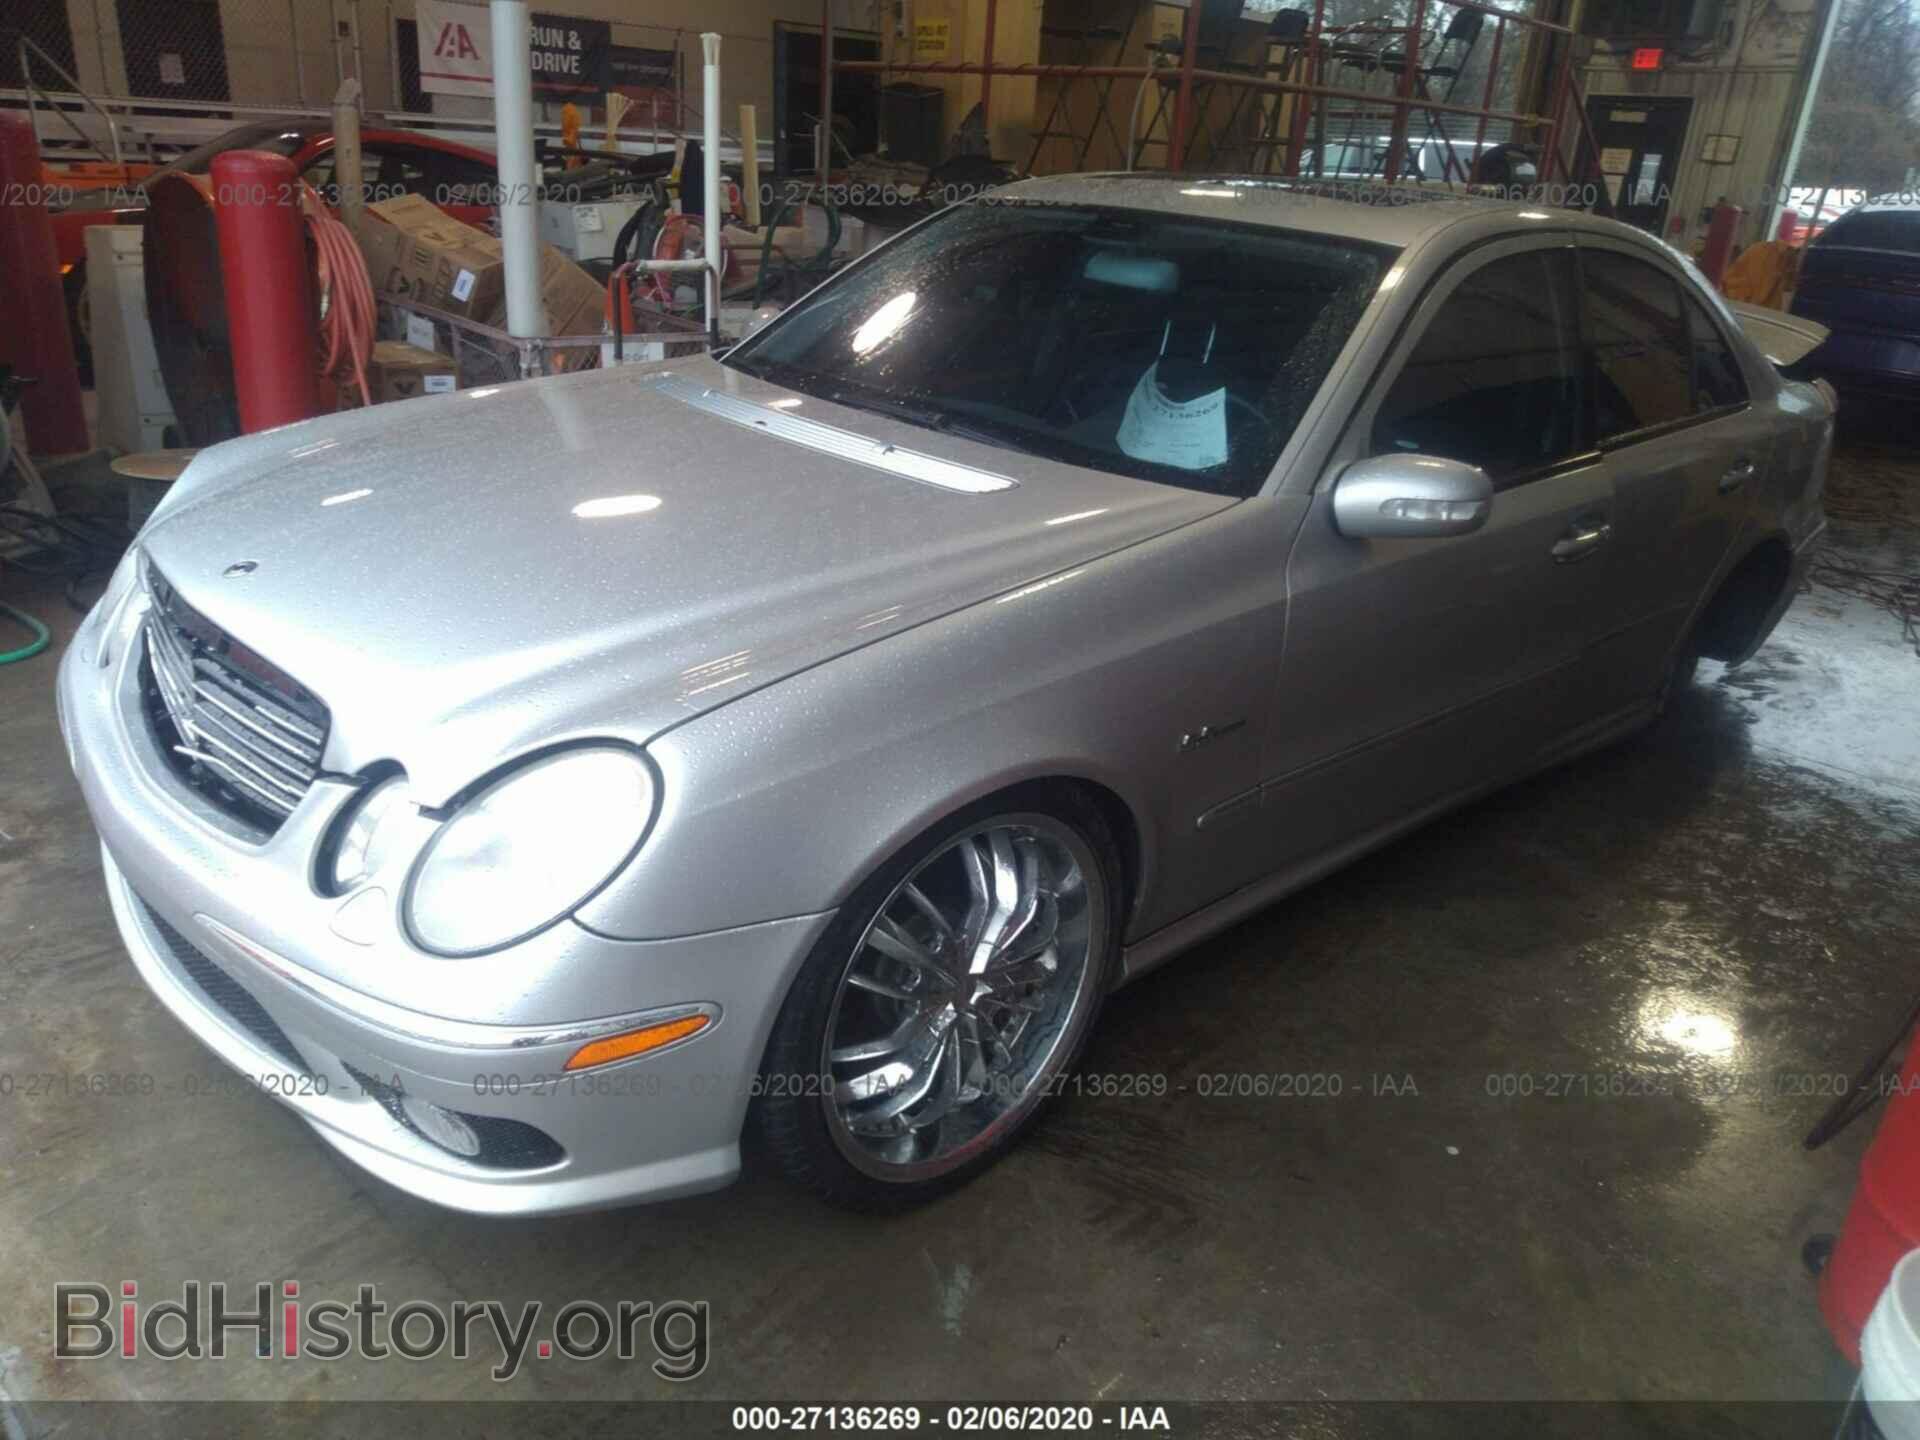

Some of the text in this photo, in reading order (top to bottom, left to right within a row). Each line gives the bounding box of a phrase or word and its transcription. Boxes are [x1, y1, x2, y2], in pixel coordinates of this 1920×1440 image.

[529, 27, 582, 50] RUN &
[532, 51, 581, 74] DRIVE
